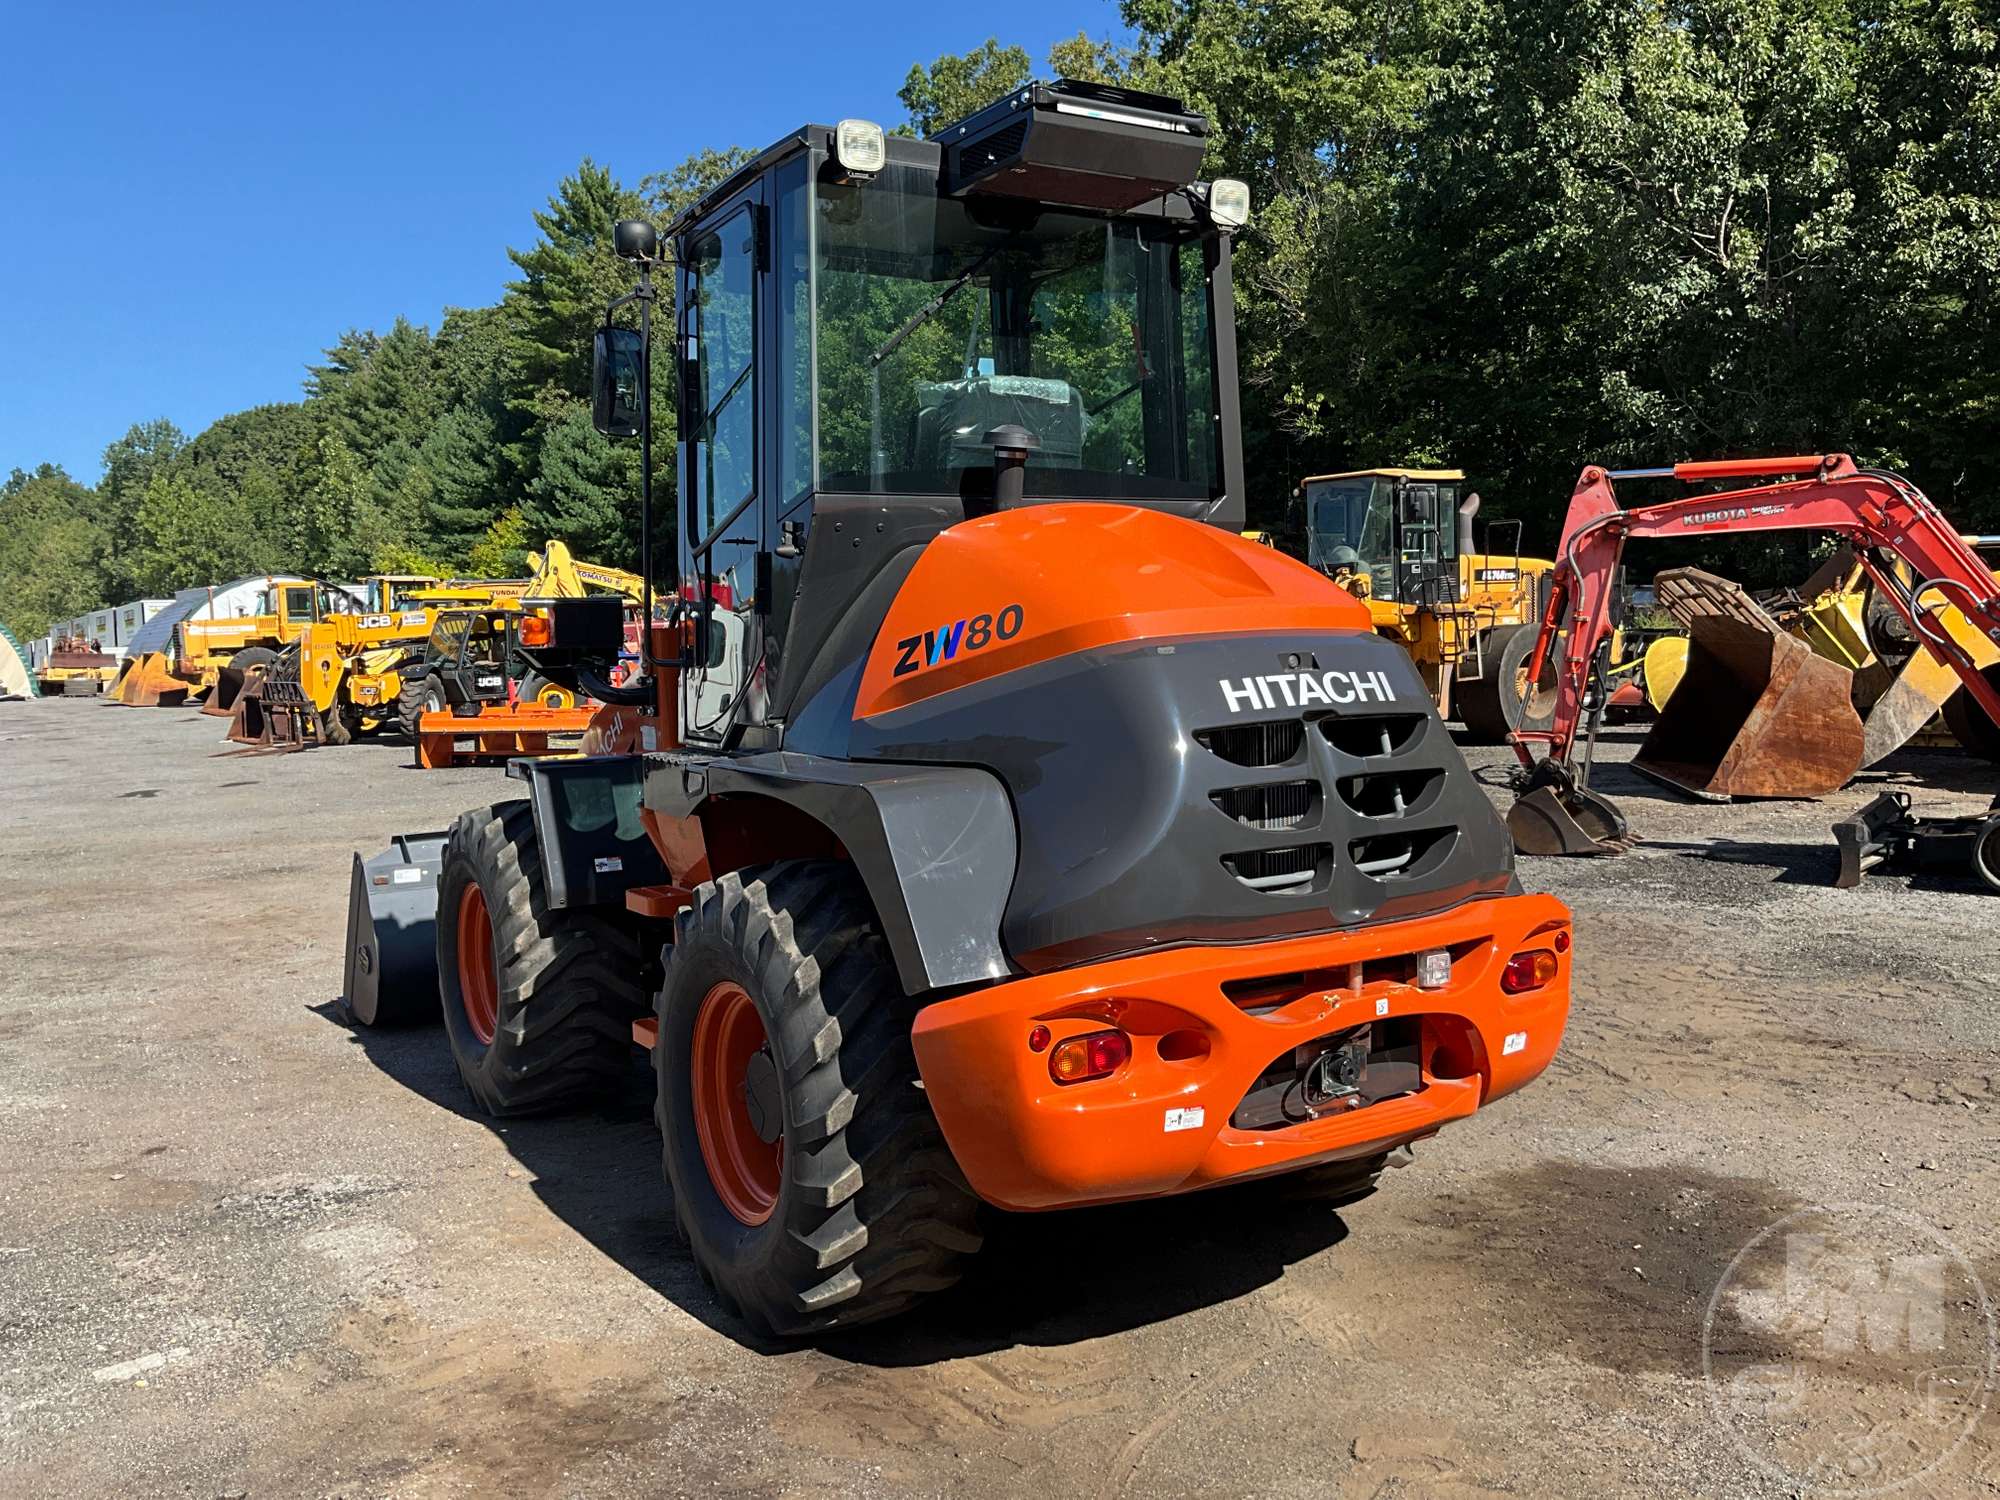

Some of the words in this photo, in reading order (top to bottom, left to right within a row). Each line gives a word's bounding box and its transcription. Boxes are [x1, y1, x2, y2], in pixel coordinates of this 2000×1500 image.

[1683, 508, 1748, 526] KUBOTA
[358, 615, 391, 629] JCB
[893, 603, 1025, 678] ZW80
[478, 676, 503, 687] JCB
[360, 686, 378, 695] JCB
[1219, 671, 1397, 713] HITACHI
